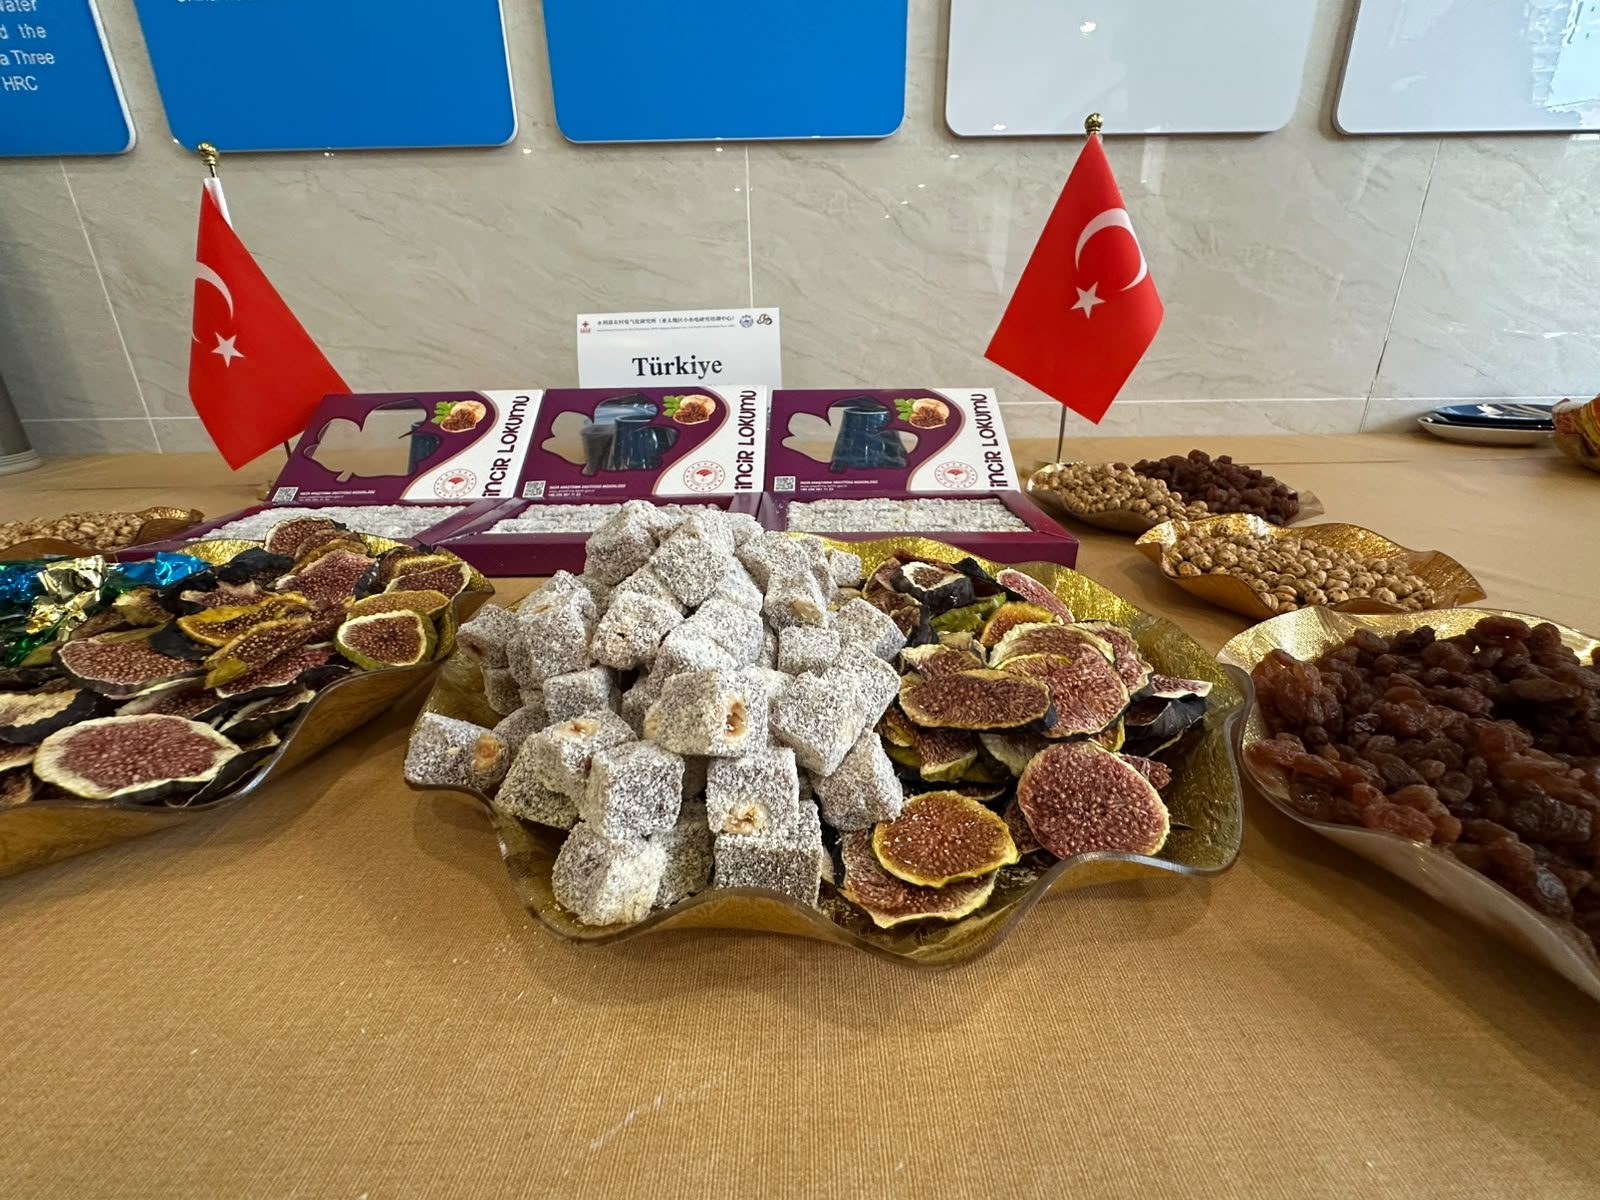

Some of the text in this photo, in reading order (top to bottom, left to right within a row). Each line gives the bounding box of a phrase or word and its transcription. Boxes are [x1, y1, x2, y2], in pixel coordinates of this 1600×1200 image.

[0, 0, 37, 12] ater
[17, 24, 47, 39] the
[10, 50, 55, 65] Three
[1, 75, 38, 91] HRC
[632, 355, 723, 379] Türkiye
